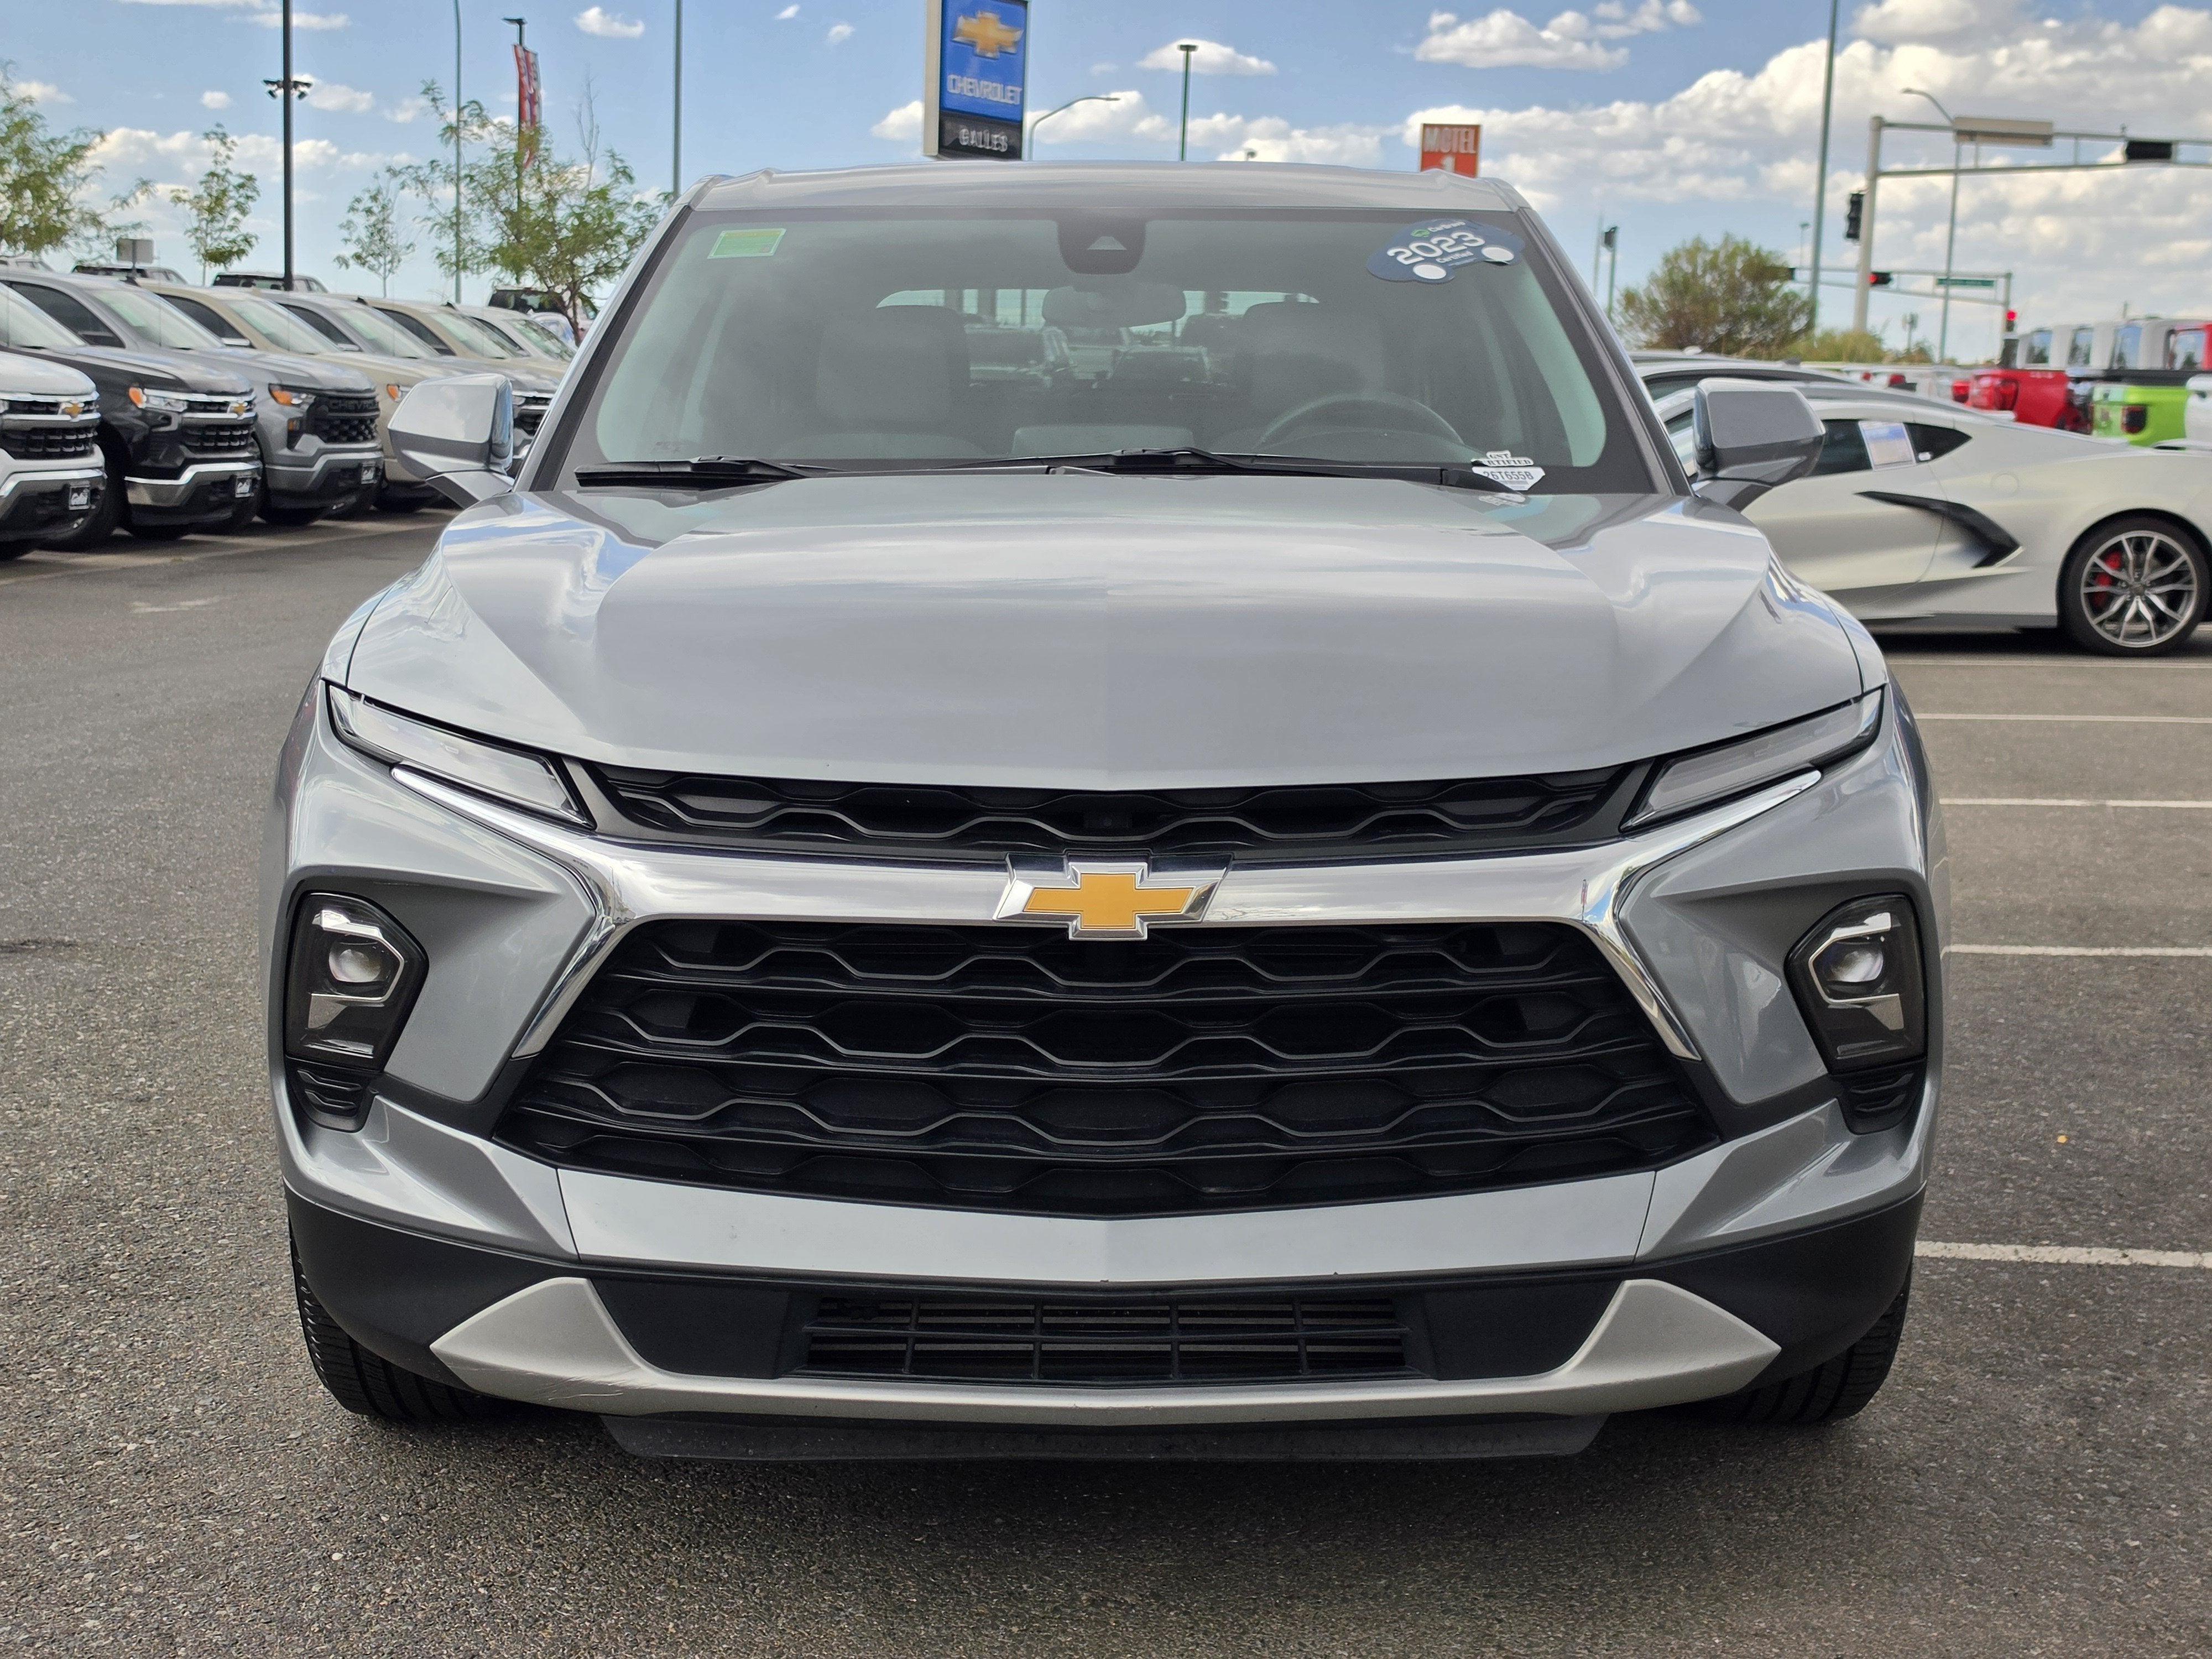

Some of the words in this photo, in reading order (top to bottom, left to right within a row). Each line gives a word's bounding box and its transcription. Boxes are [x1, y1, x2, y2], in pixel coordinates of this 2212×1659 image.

[947, 74, 1022, 105] CHEVROLET
[958, 128, 1008, 152] GALLES
[1423, 127, 1476, 154] MOTEL
[1387, 232, 1485, 265] 2023
[1436, 252, 1474, 263] Certified
